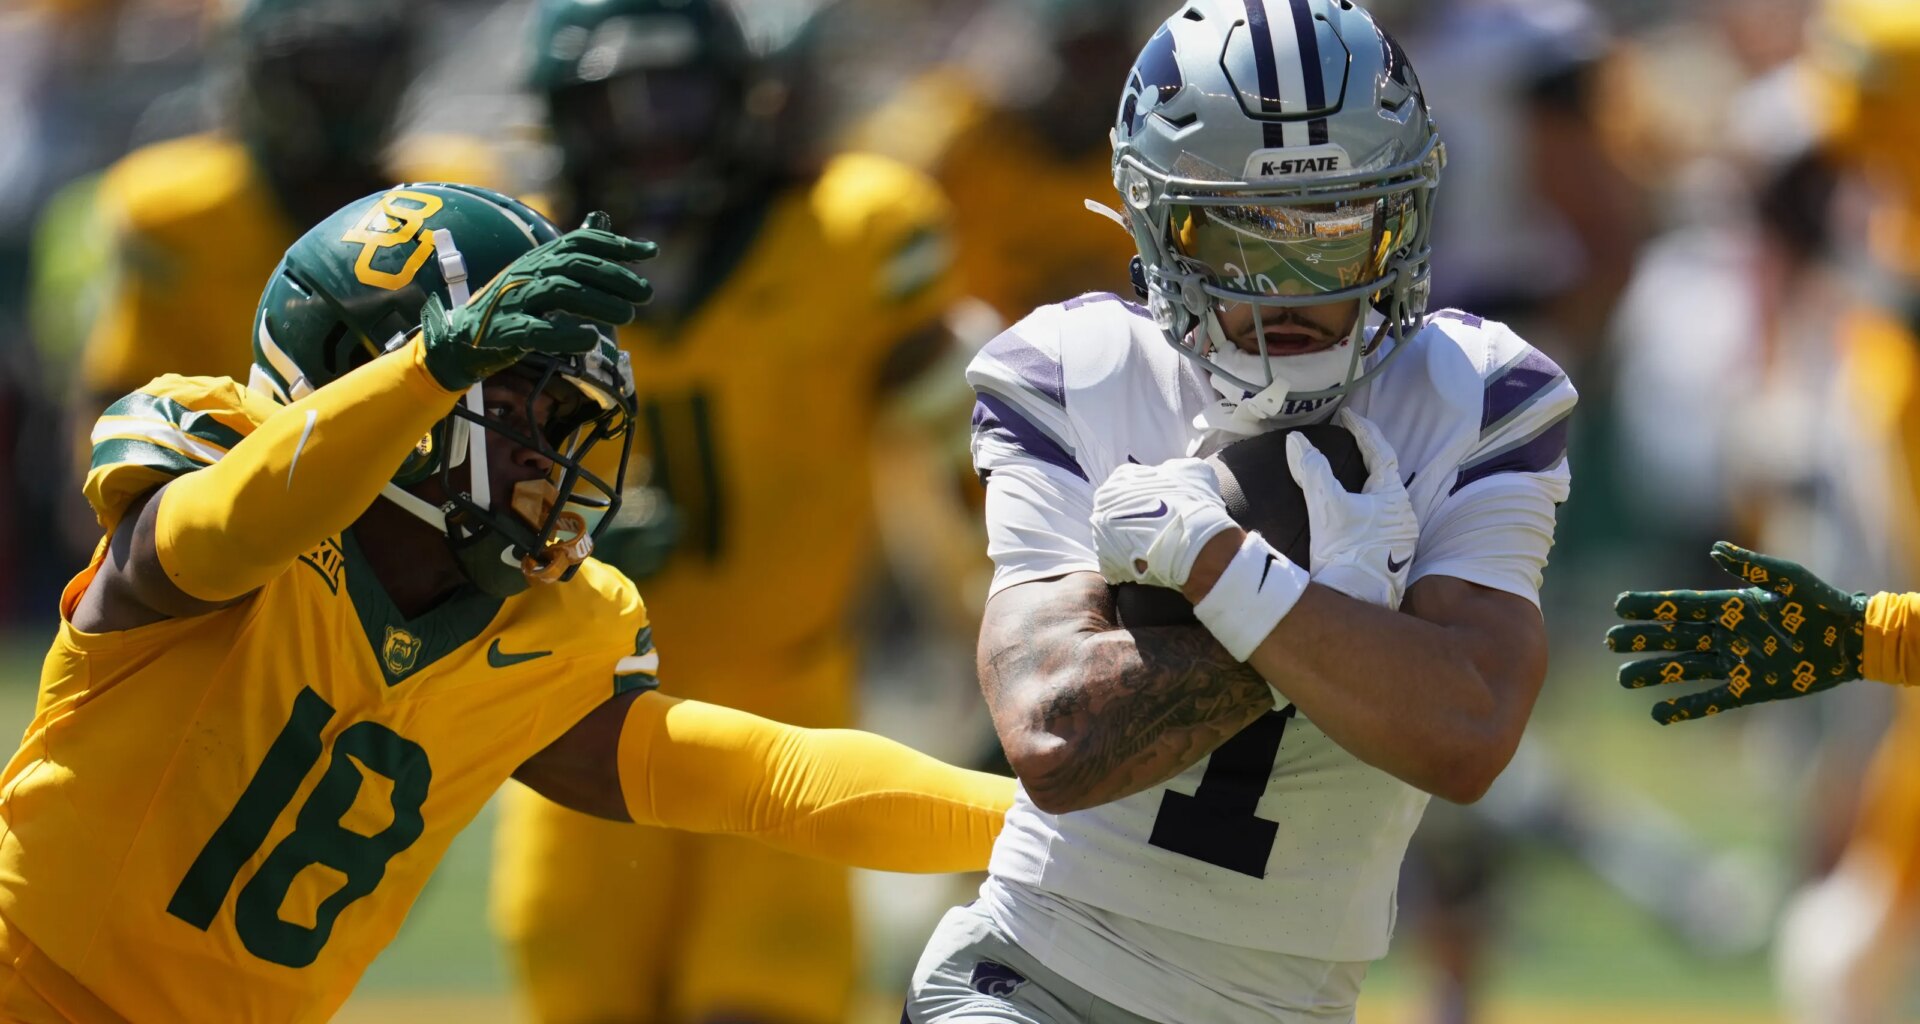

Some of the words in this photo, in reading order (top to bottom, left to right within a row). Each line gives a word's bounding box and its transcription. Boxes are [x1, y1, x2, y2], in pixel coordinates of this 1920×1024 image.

[1260, 156, 1339, 176] K-STATE
[341, 190, 443, 291] BU
[166, 685, 432, 968] 18
